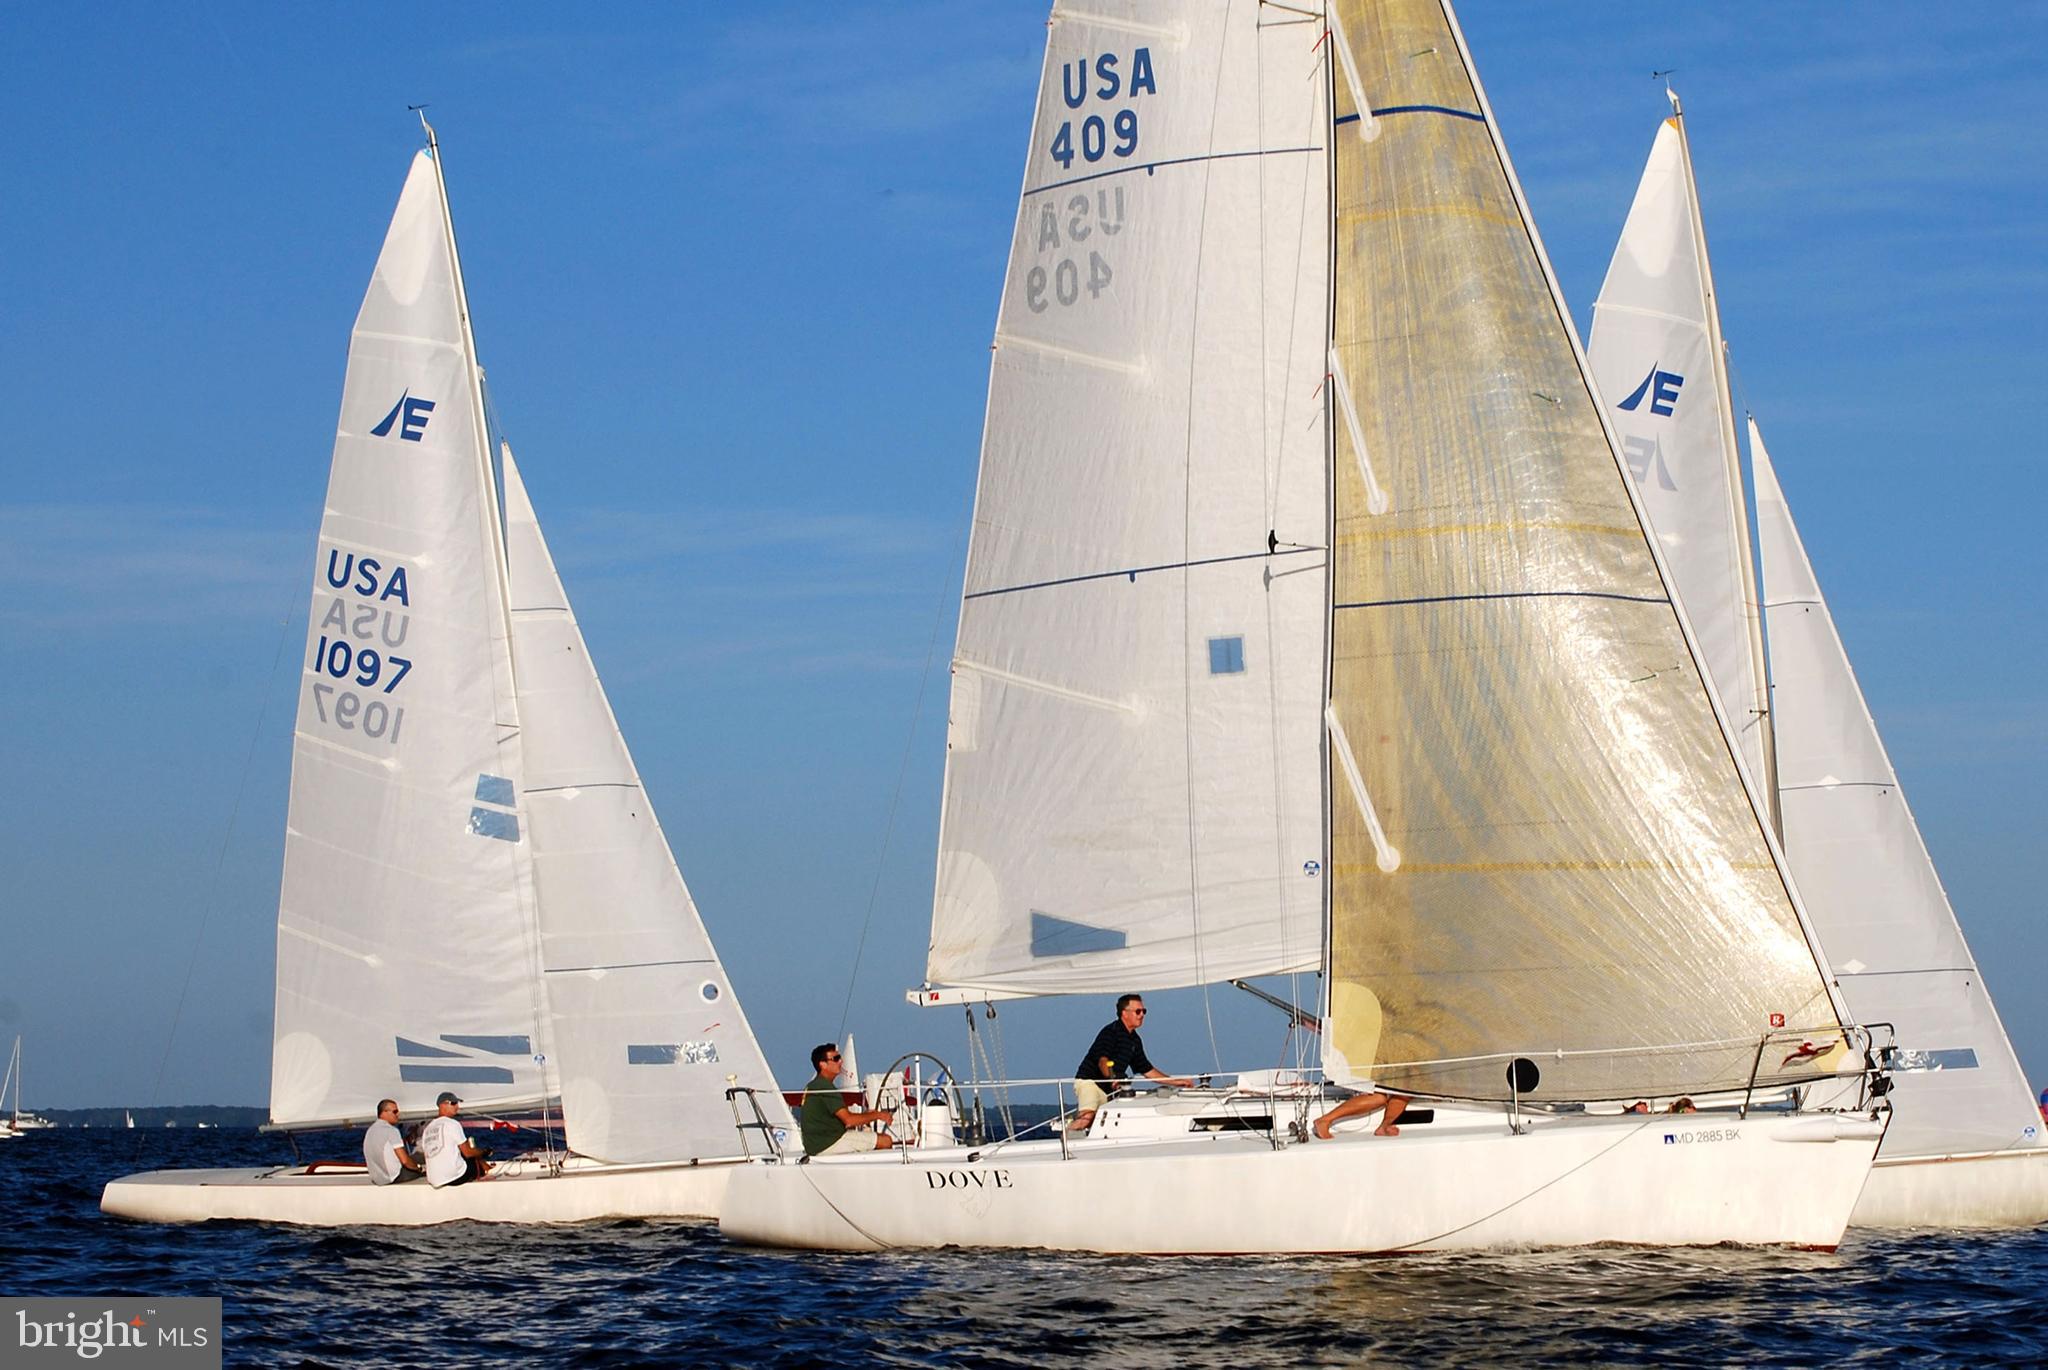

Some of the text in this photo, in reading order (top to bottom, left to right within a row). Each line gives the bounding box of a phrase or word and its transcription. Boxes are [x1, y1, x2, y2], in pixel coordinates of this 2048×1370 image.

[1063, 47, 1156, 109] USA
[1050, 109, 1138, 169] 409
[327, 549, 410, 606] USA
[314, 636, 412, 694] 1097
[1674, 1128, 1742, 1144] MD 2885 BK
[925, 1169, 1014, 1189] DOVE
